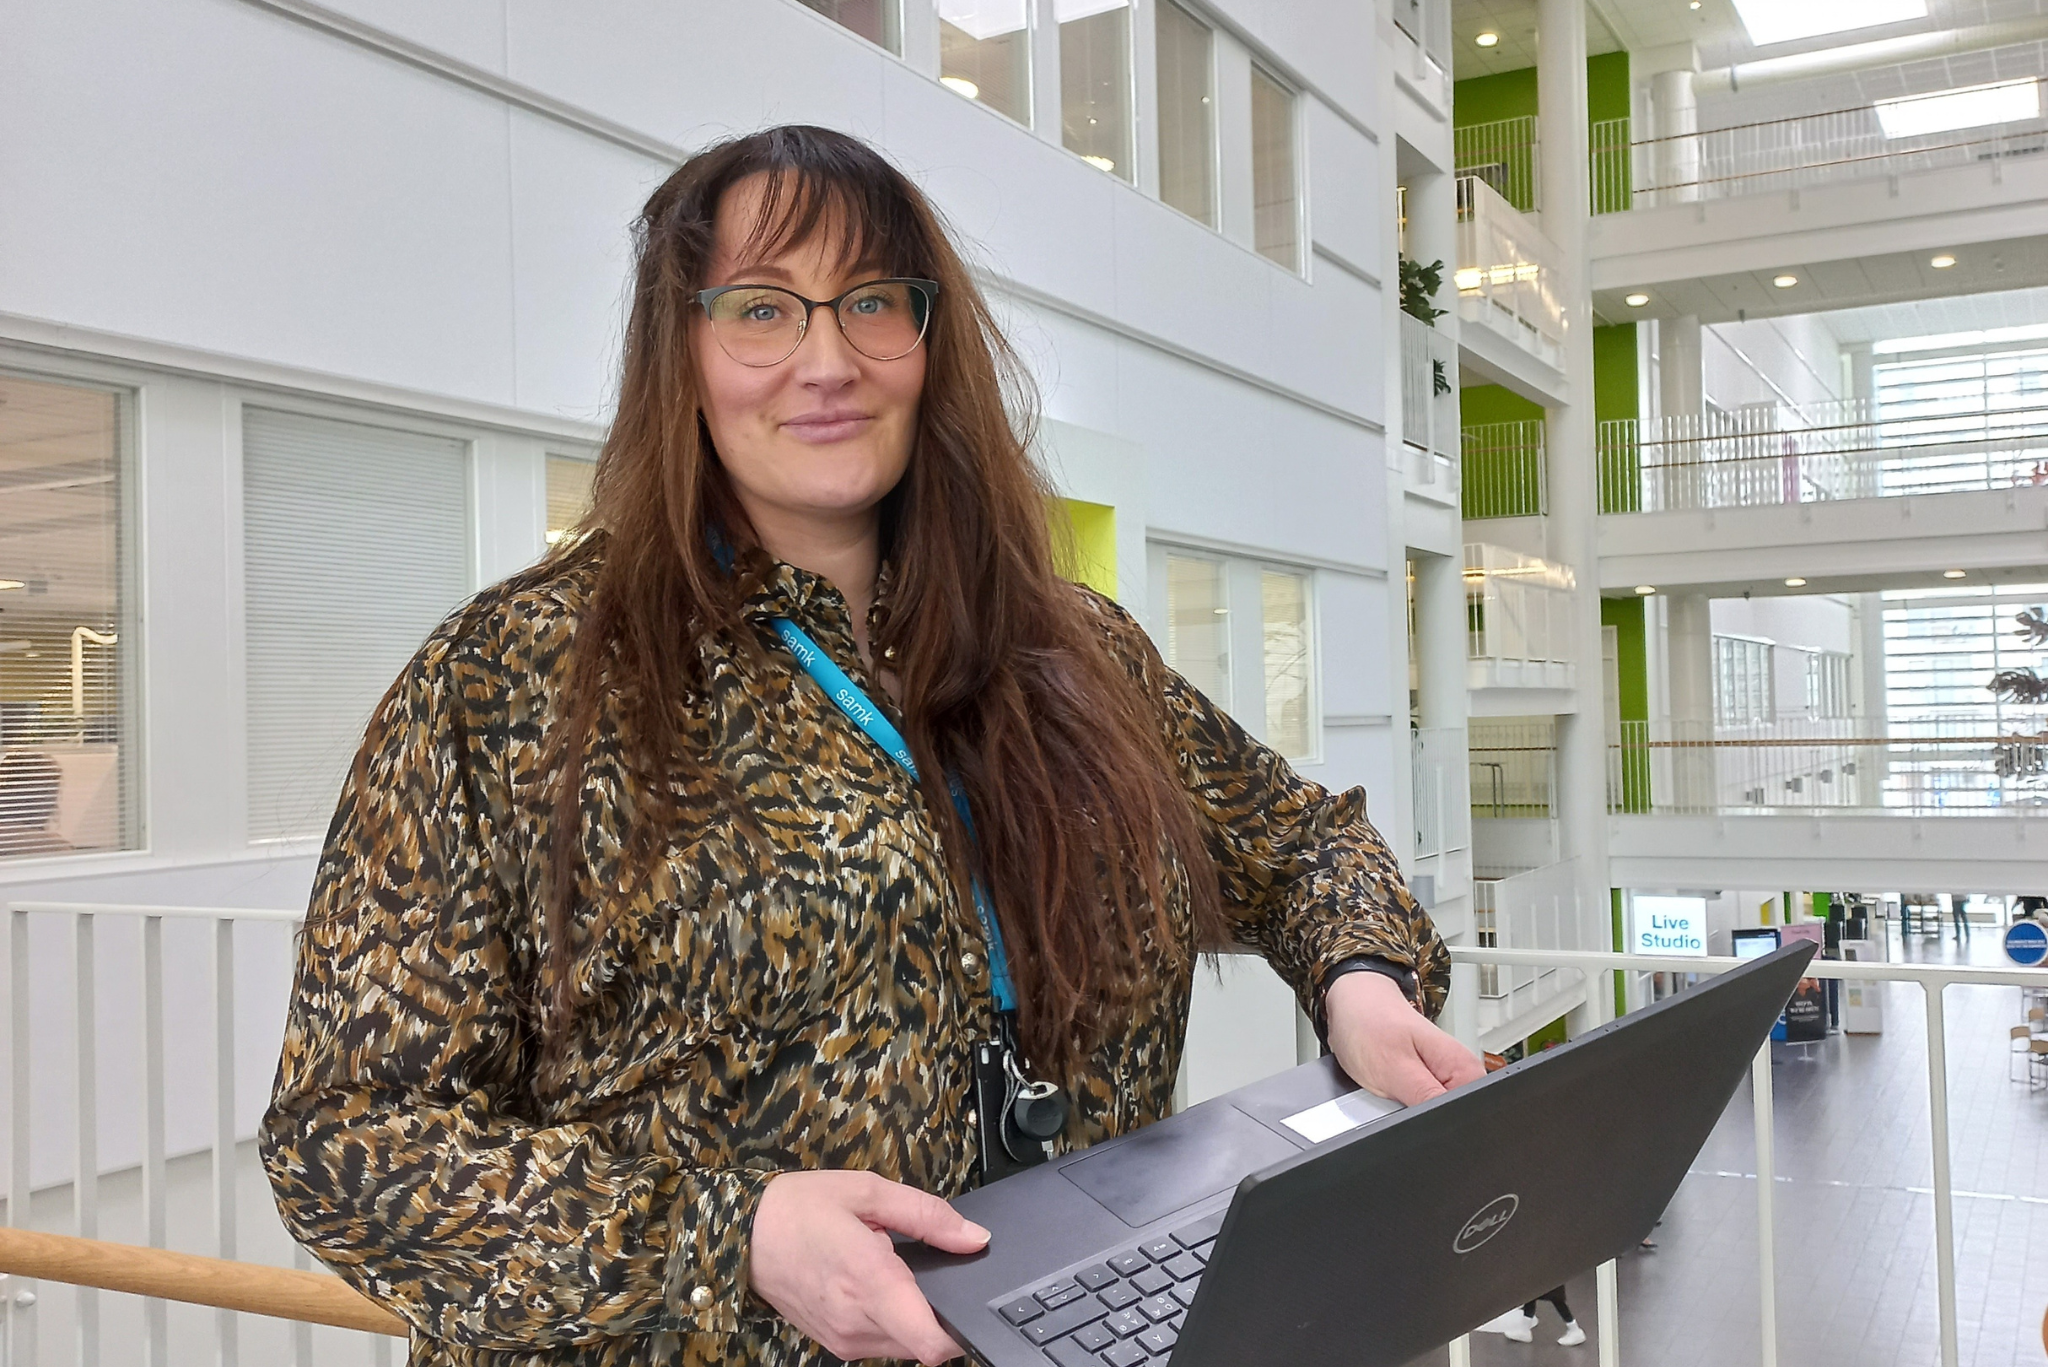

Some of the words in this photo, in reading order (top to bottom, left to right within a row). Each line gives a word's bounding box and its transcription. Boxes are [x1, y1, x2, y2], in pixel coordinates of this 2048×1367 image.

[781, 629, 816, 668] samk
[836, 688, 874, 726] samk
[1652, 914, 1689, 930] Live
[1641, 932, 1701, 949] Studio
[1462, 1209, 1507, 1240] DELL
